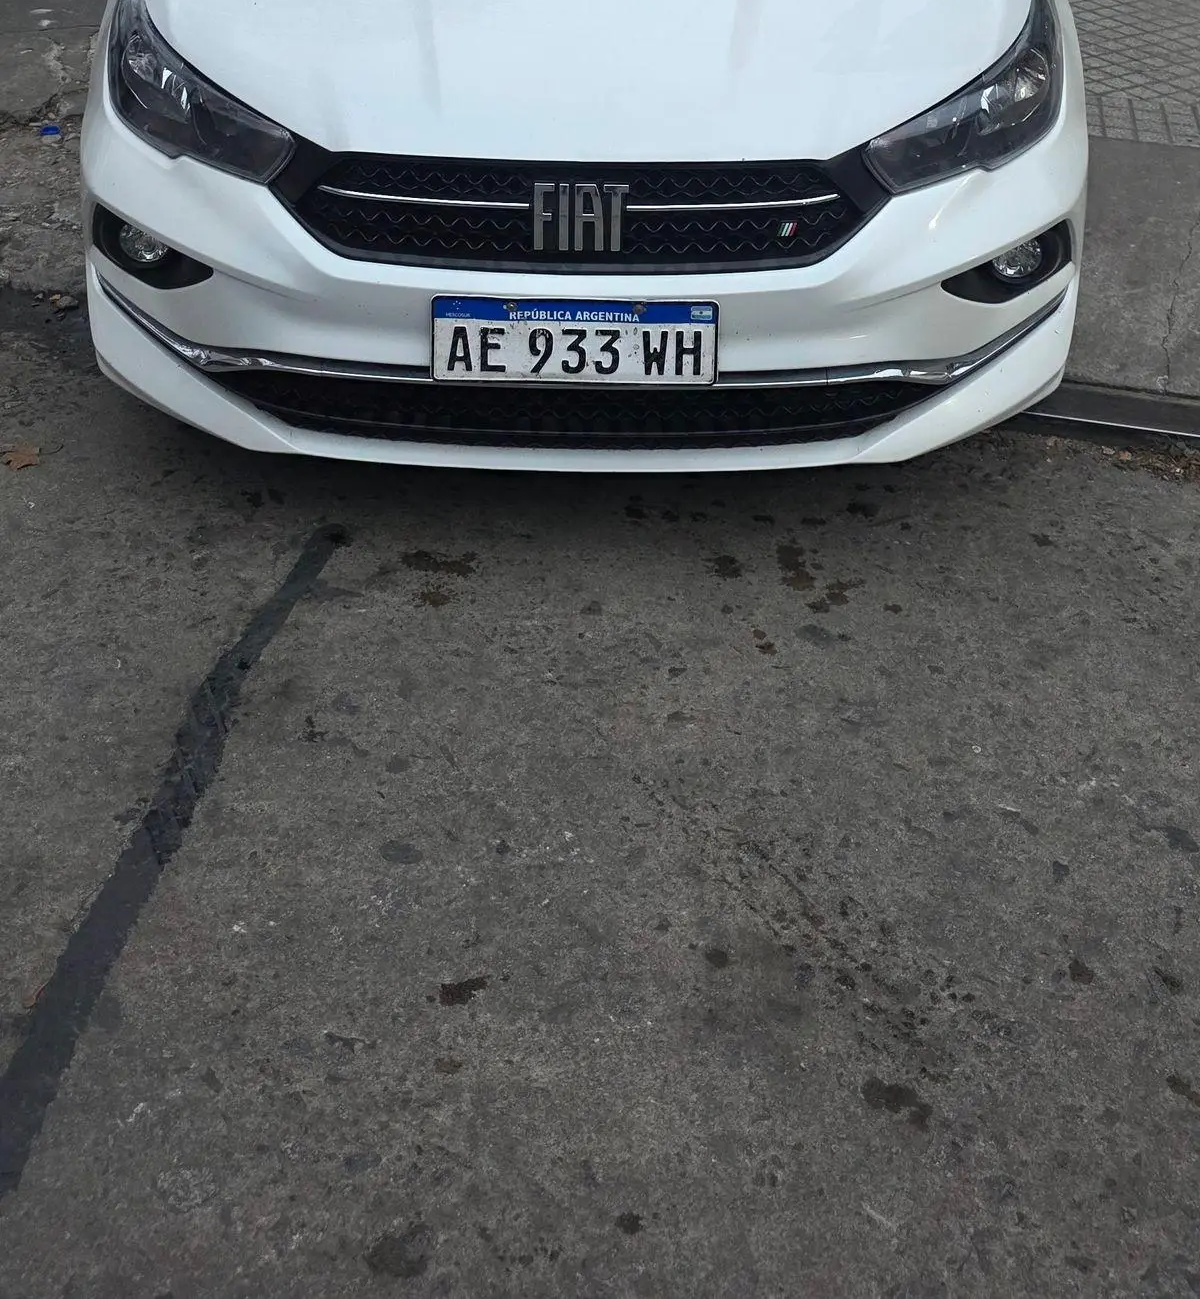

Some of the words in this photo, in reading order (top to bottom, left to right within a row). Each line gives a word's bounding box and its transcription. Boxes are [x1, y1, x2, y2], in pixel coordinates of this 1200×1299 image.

[533, 183, 629, 251] FIAT
[509, 308, 572, 320] REPÚBLICA
[575, 311, 640, 322] ARGENTINA
[447, 326, 506, 373] AE
[528, 327, 620, 375] 933
[642, 330, 701, 376] WH
